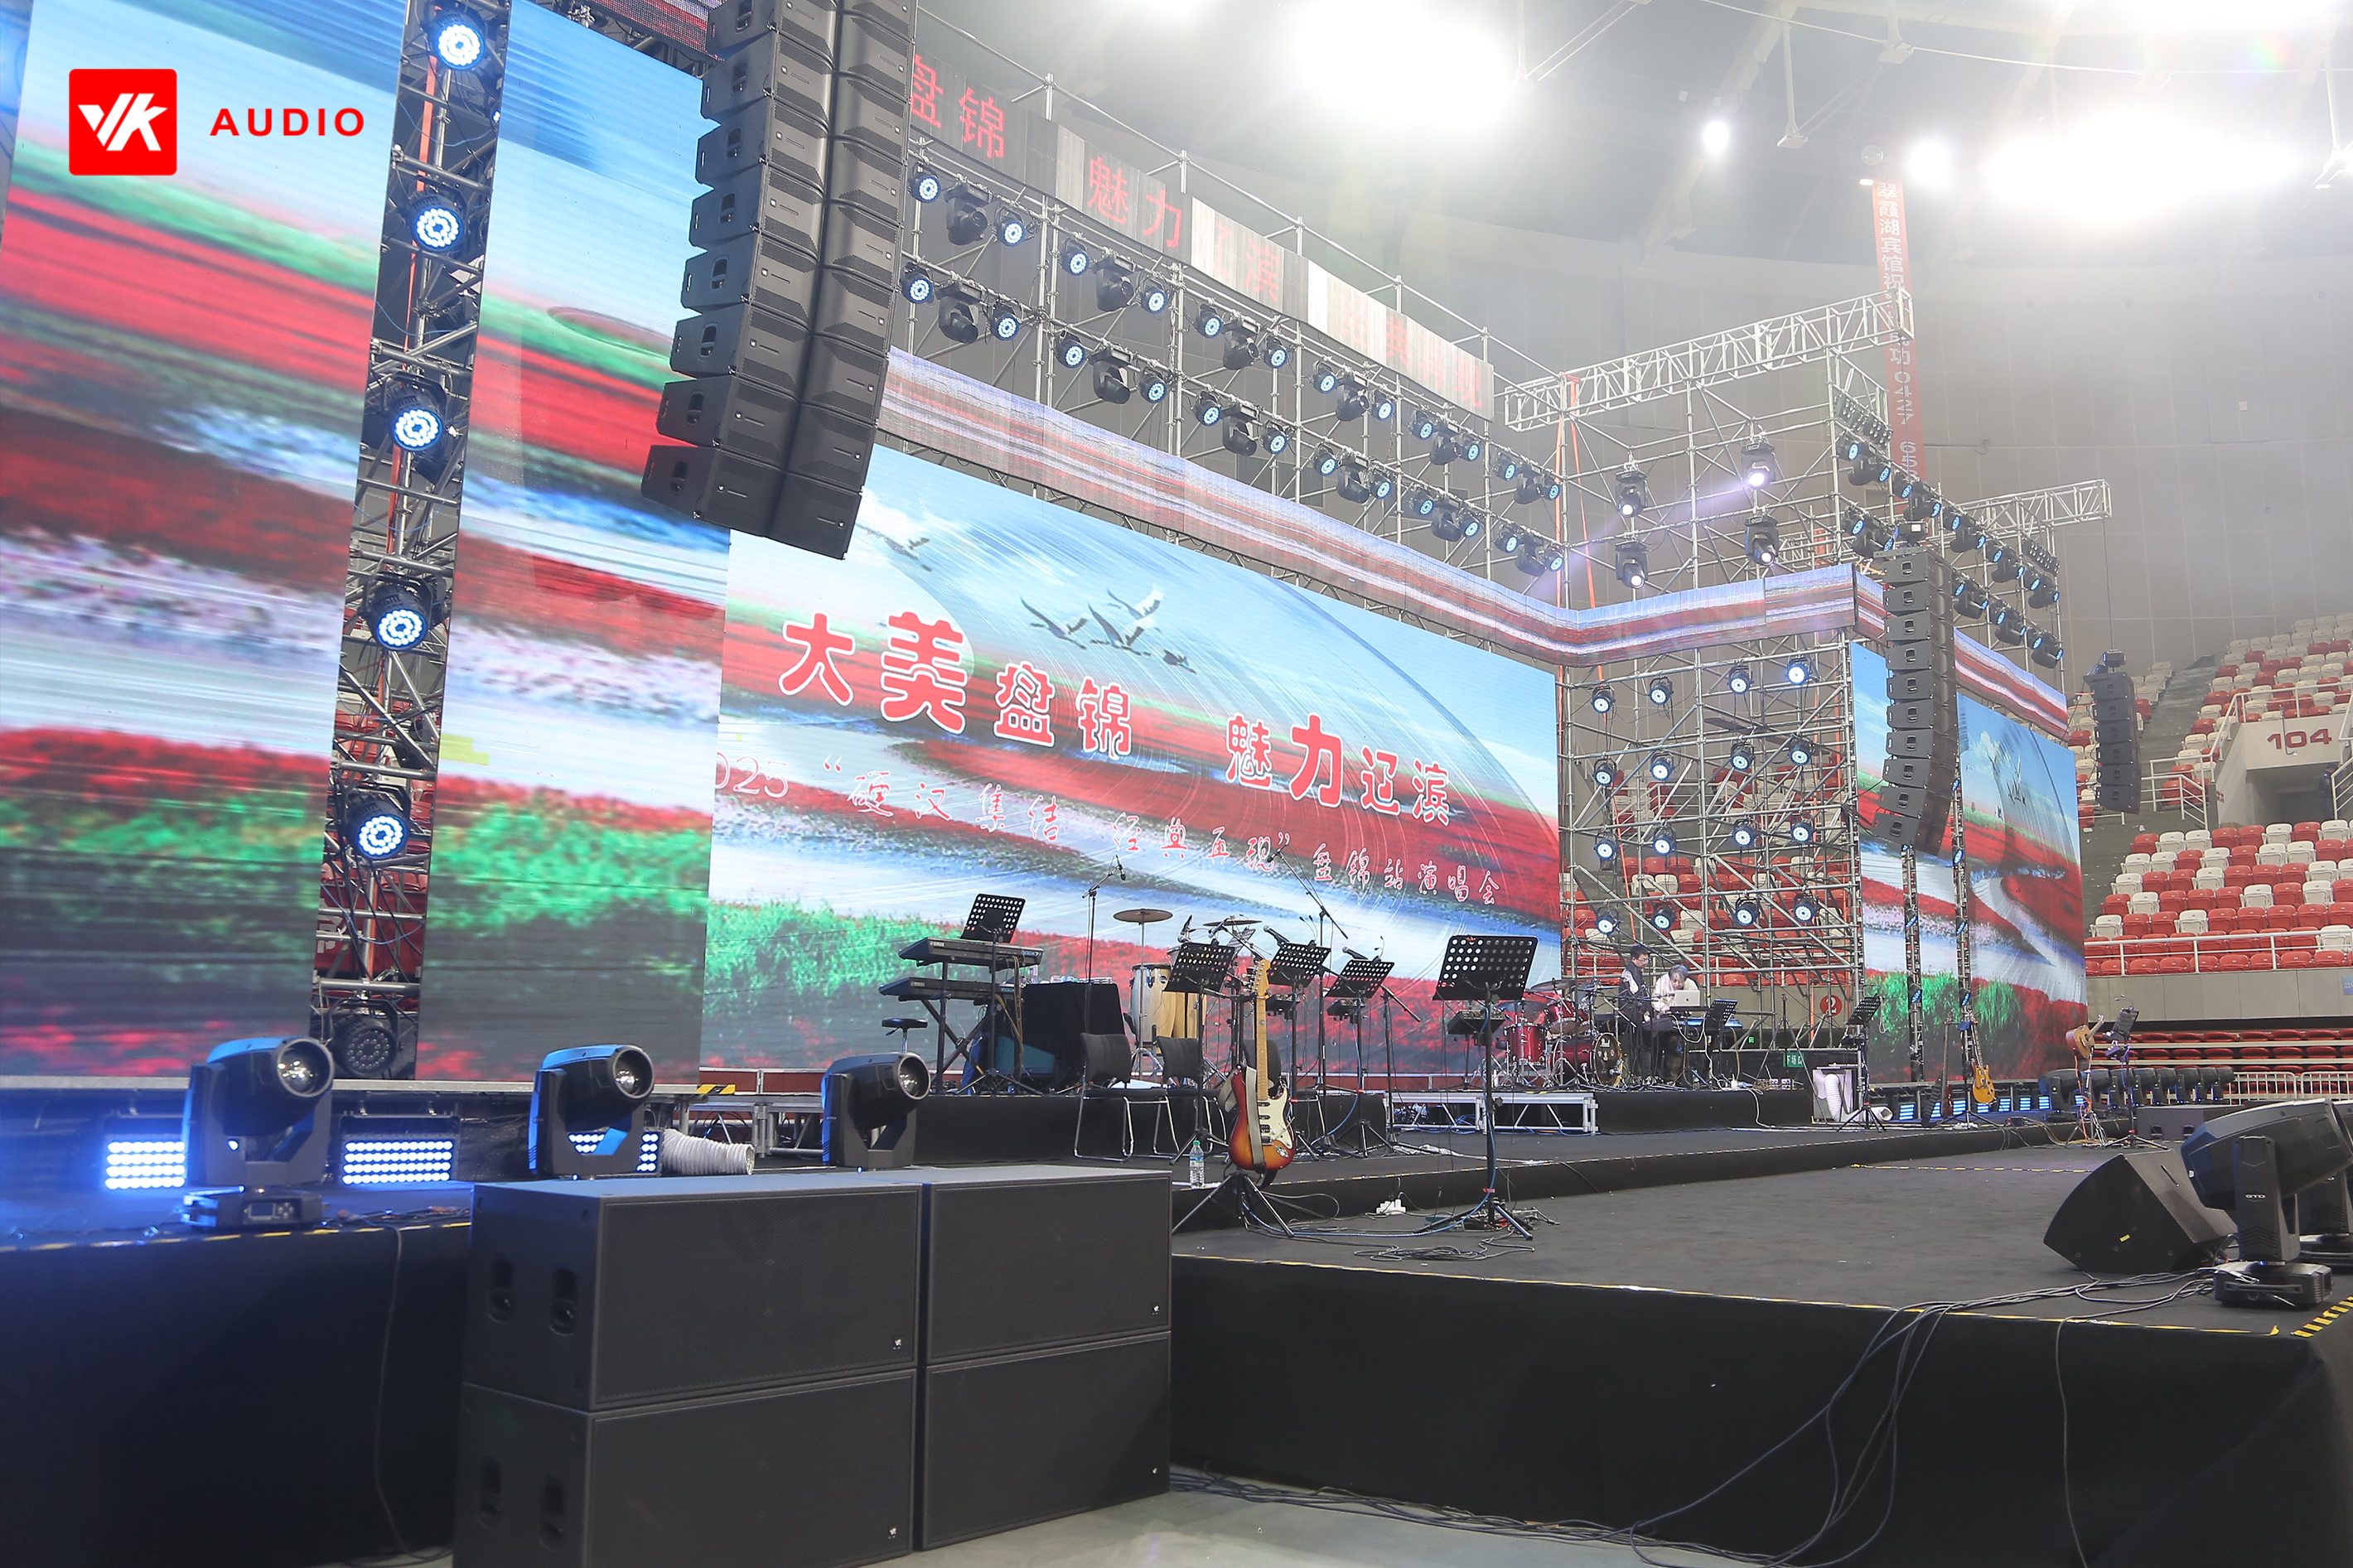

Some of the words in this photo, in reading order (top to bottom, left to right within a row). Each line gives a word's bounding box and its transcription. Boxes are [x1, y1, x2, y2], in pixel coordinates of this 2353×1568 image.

[779, 611, 1133, 760] 大美盘锦
[1225, 713, 1451, 826] 魅力辽滨
[2267, 728, 2332, 750] 104
[1825, 996, 1838, 1014] 2
